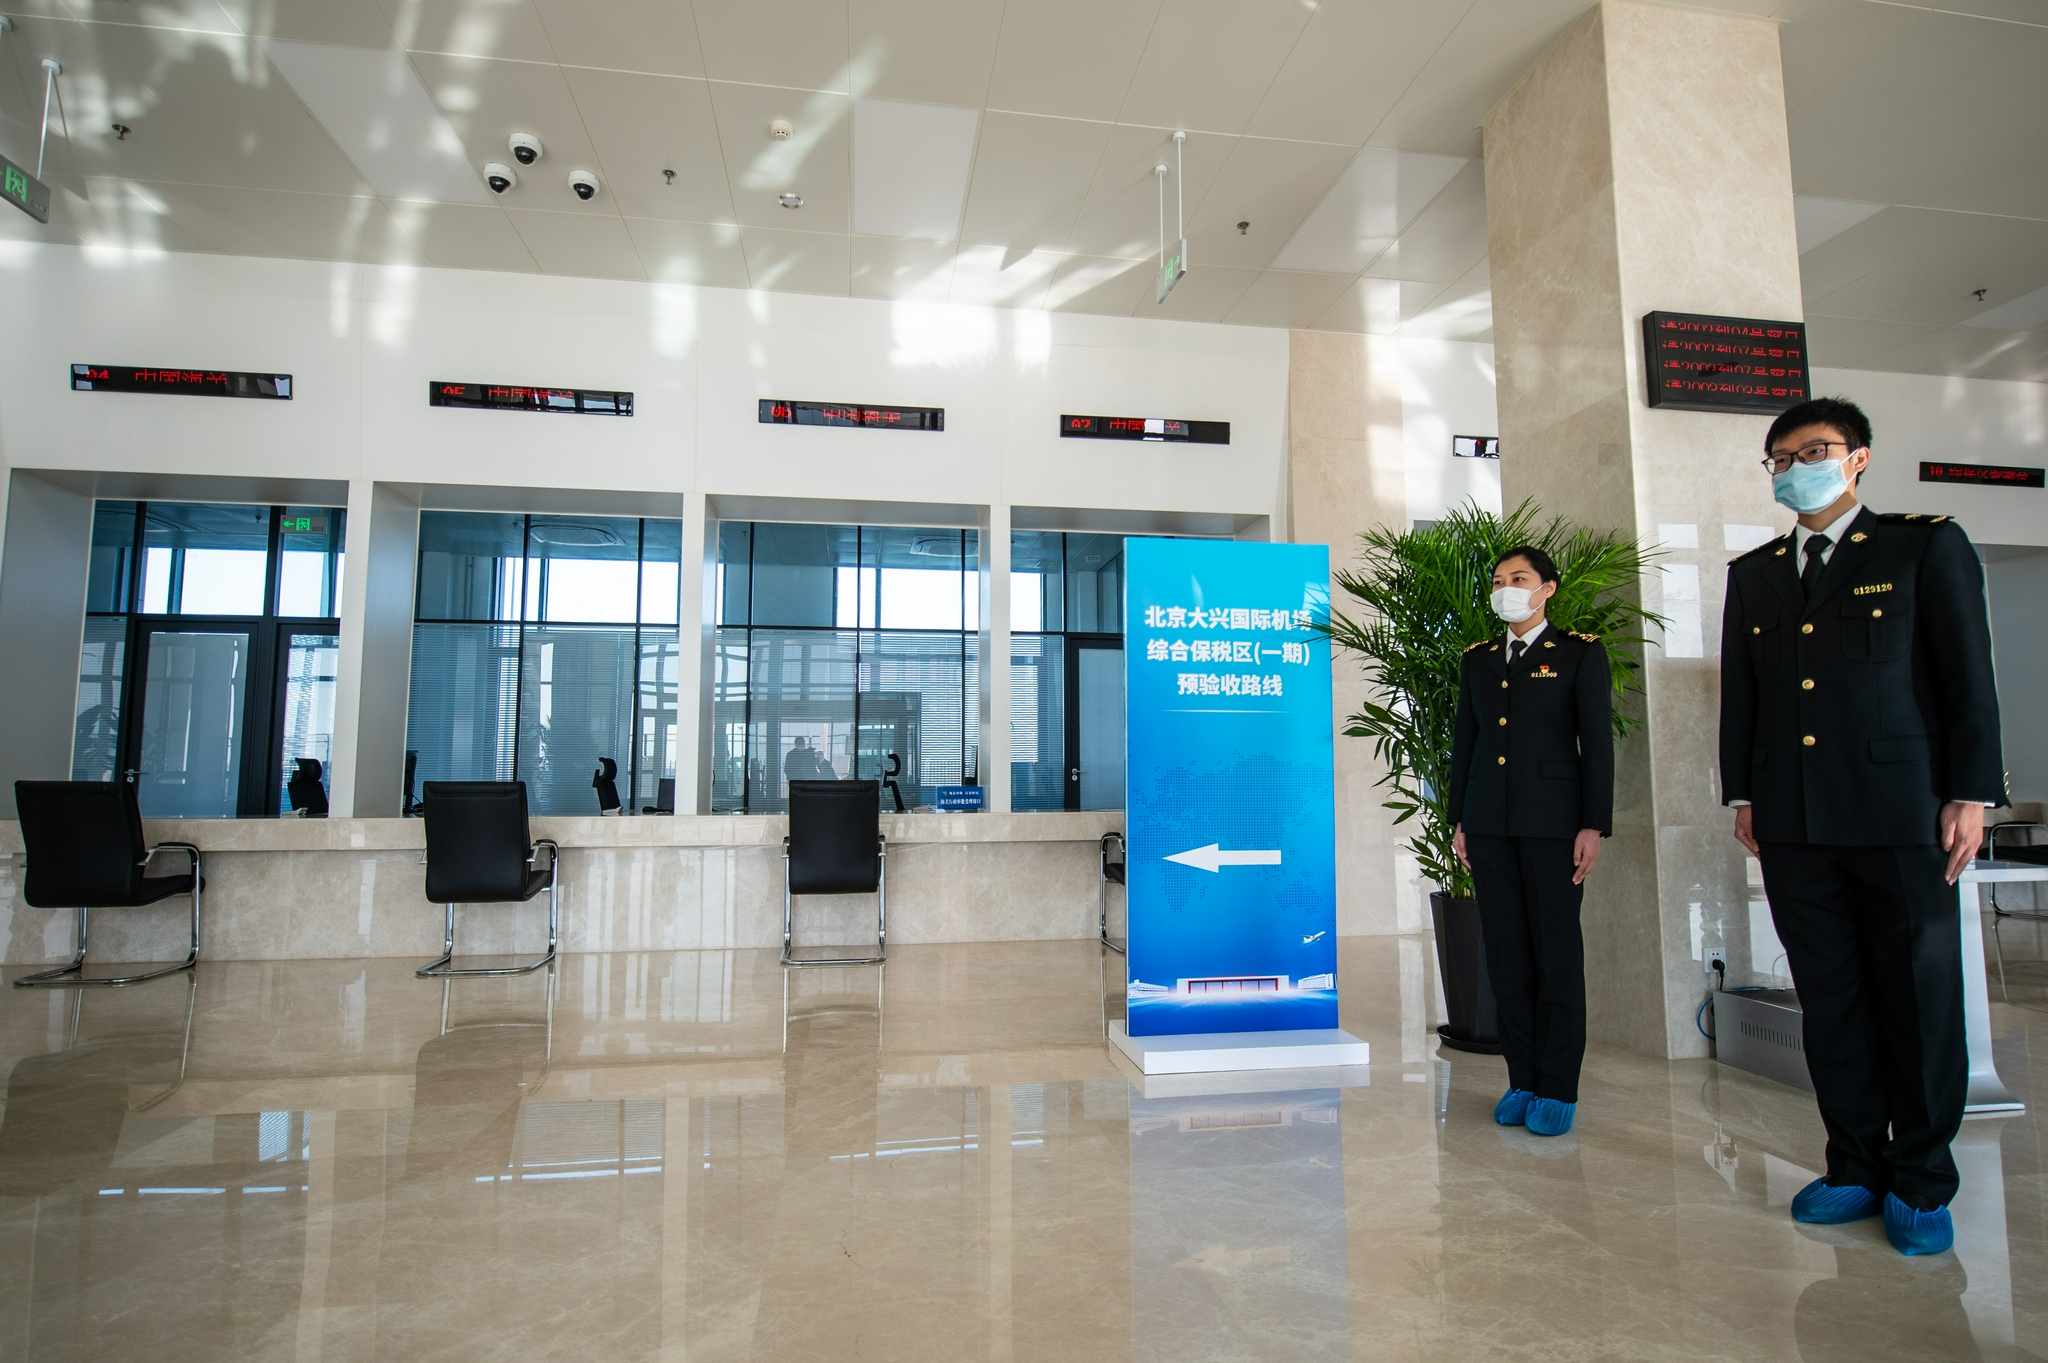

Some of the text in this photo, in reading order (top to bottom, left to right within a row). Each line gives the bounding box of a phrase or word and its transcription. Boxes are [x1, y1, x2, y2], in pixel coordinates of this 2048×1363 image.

[1853, 583, 1893, 595] 0129120
[1145, 605, 1312, 632] 北京大兴国际机场
[1146, 639, 1311, 667] 综合保税区(一期)
[1177, 673, 1283, 697] 预验收路线
